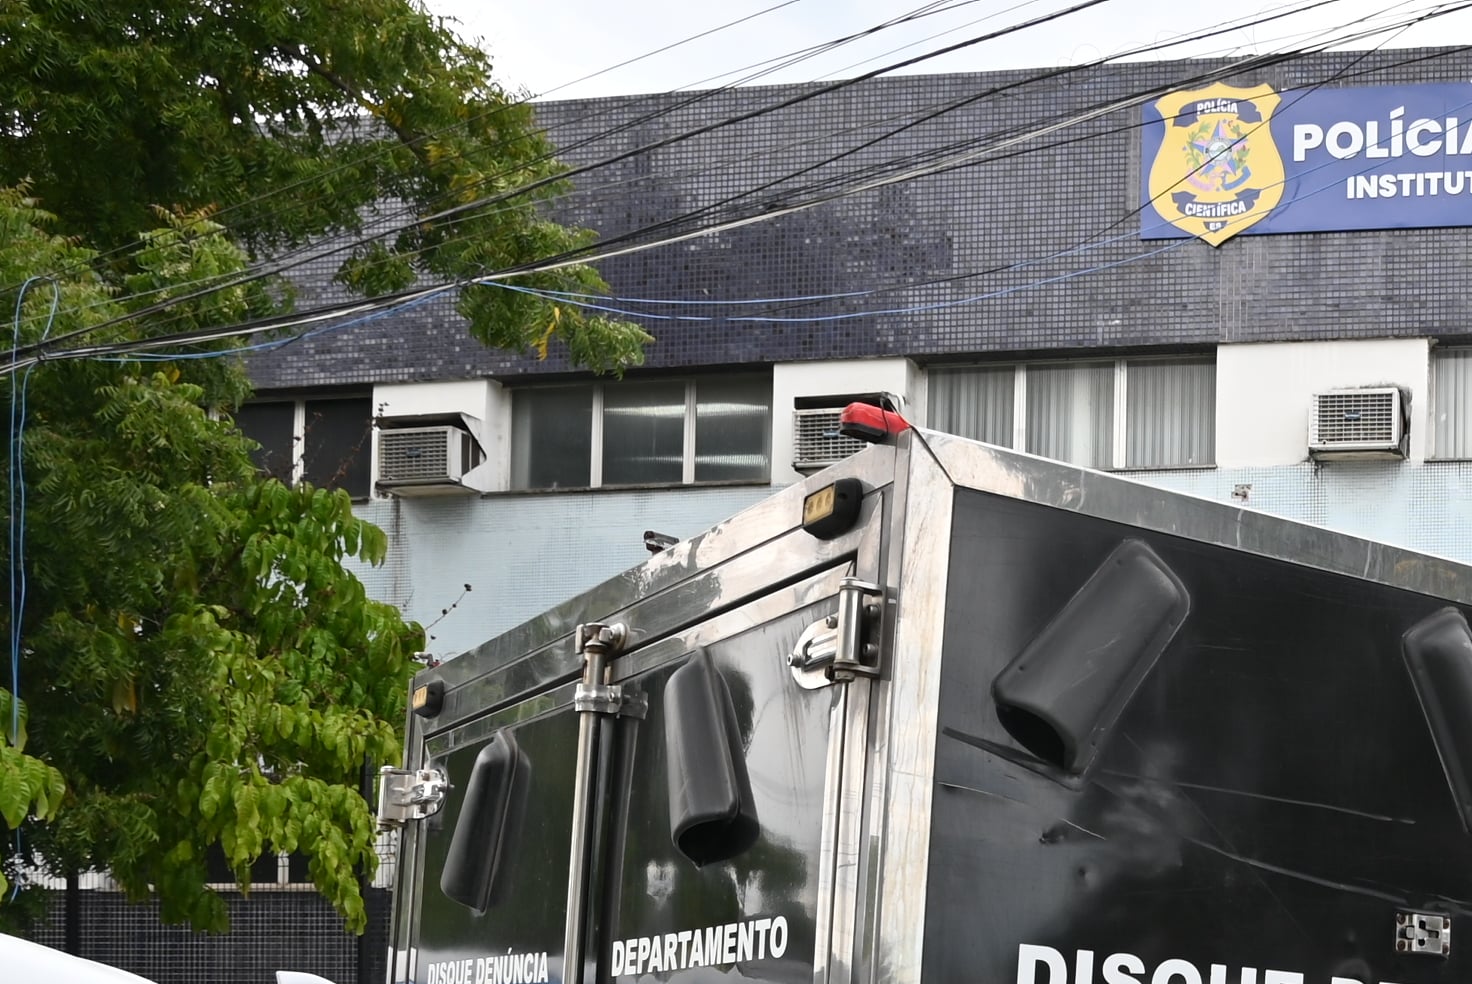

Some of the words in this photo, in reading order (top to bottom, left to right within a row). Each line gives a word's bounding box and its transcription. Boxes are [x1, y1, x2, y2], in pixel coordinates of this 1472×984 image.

[1197, 98, 1238, 114] POLÍCIA
[1185, 201, 1246, 217] CIENTÍFICA
[611, 915, 789, 977] DEPARTAMENTO
